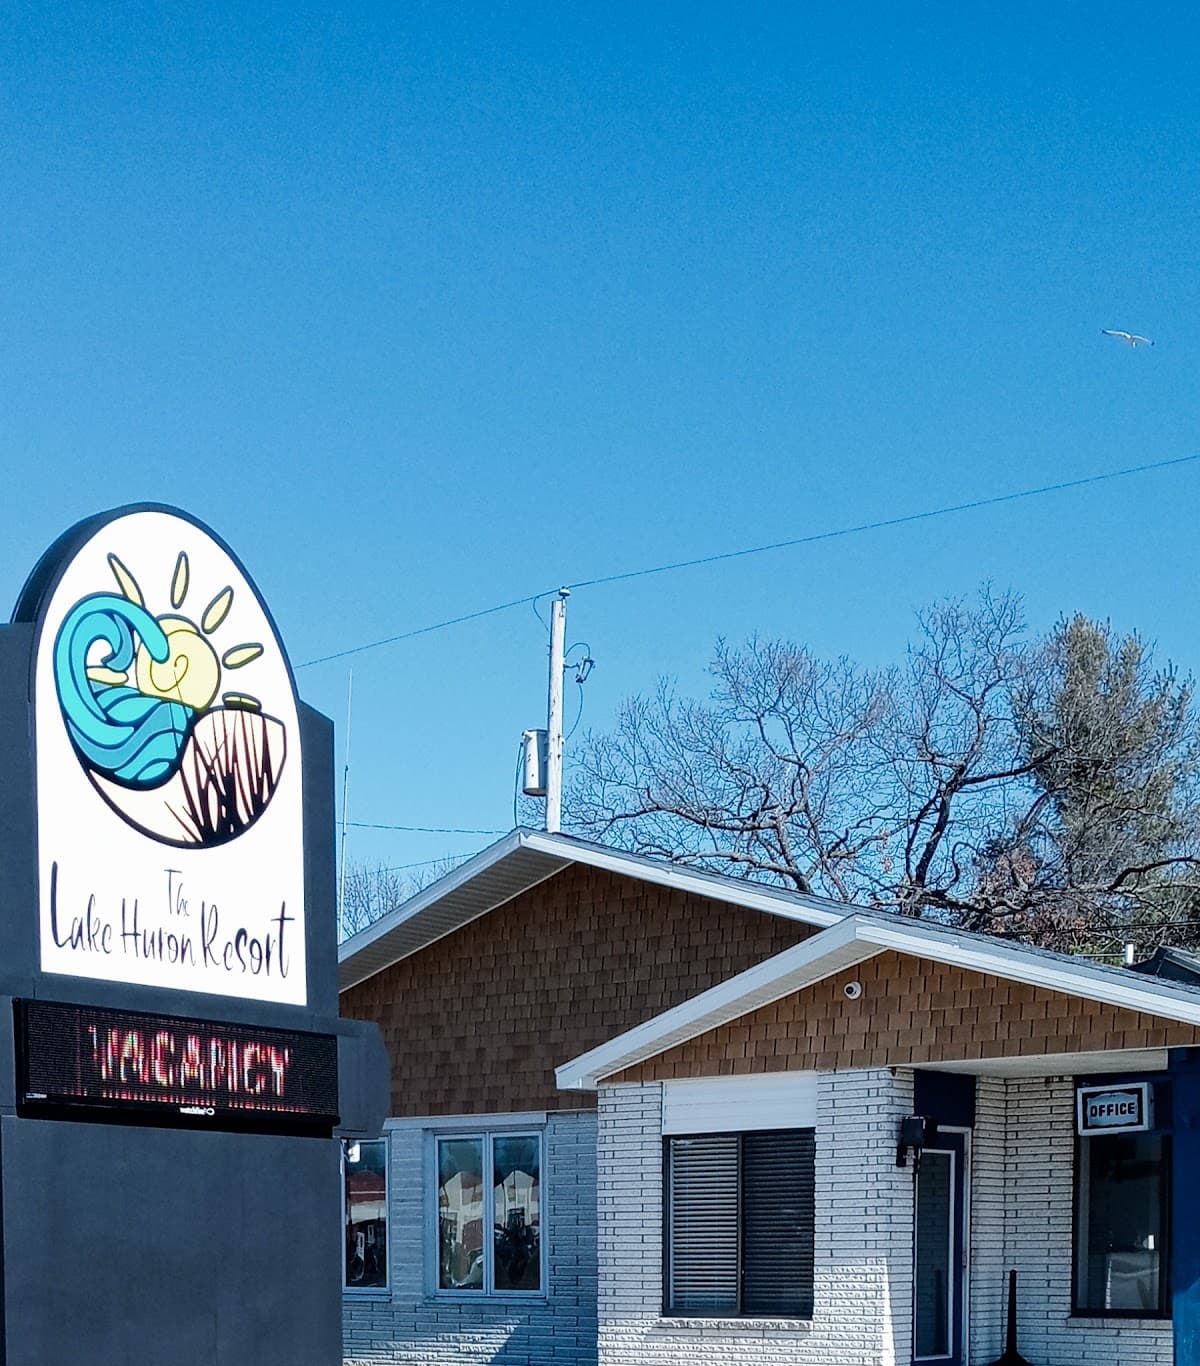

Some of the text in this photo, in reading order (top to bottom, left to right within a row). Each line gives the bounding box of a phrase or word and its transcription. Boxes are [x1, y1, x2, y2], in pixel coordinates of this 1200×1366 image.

[51, 861, 295, 979] Lake Huron Resort
[164, 869, 190, 917] The
[88, 1024, 290, 1096] VACANCY
[1090, 1102, 1136, 1118] OFFICE
